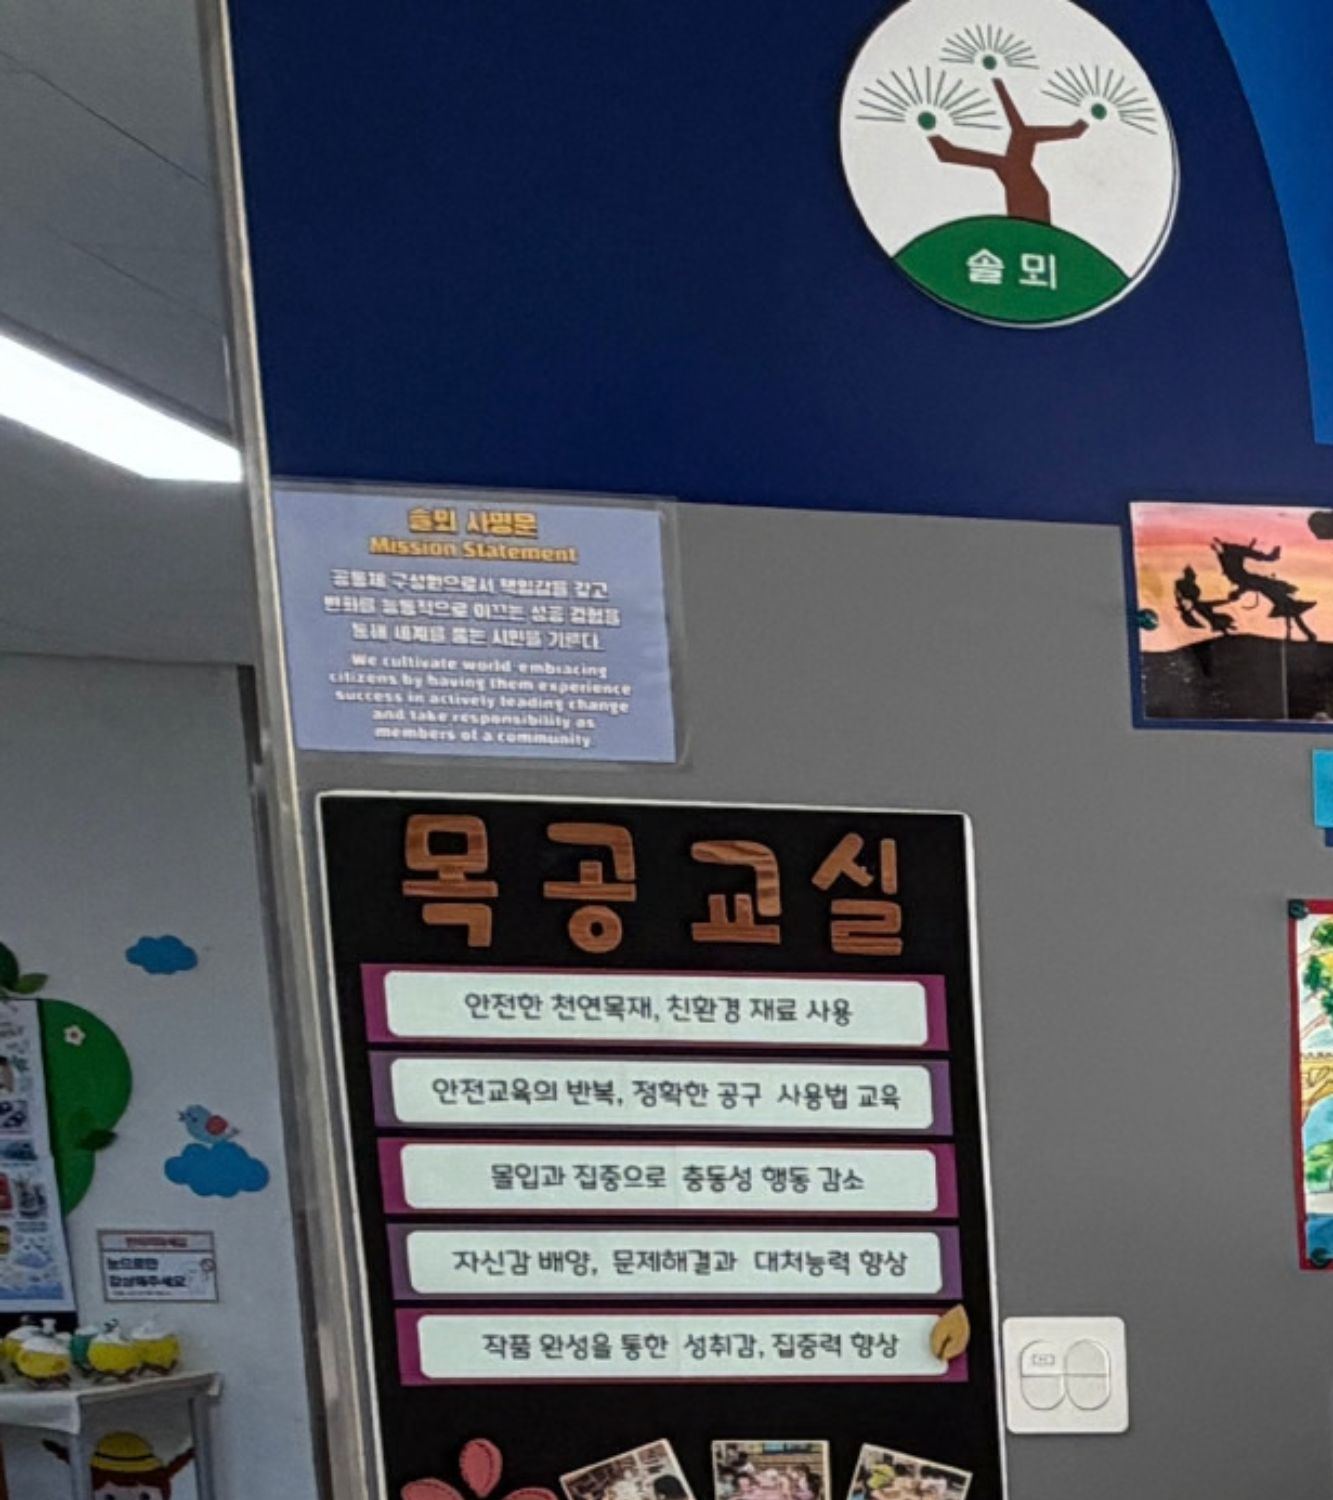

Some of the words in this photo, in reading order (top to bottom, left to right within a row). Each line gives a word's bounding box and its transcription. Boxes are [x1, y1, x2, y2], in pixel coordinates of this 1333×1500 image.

[966, 248, 1058, 291] 솔뫼
[368, 536, 457, 557] Mission
[462, 542, 579, 565] Statement
[473, 602, 527, 623] 이끄는
[352, 653, 377, 667] We
[382, 655, 457, 671] cultivate
[329, 672, 398, 685] citizens
[402, 674, 423, 688] by
[427, 676, 485, 691] having
[489, 678, 534, 691] them
[538, 681, 632, 698] experience
[407, 691, 425, 704] in
[429, 693, 495, 709] actively
[500, 695, 563, 712] leading
[569, 700, 629, 716] change
[372, 708, 405, 722] and
[410, 710, 448, 724] take
[452, 712, 571, 729] responsibility
[575, 717, 596, 730] as
[374, 725, 456, 741] members
[460, 728, 479, 742] of
[483, 731, 494, 743] a
[402, 814, 903, 955] 목공교실
[464, 992, 543, 1021] 안전한
[551, 994, 659, 1022] 천연목재,
[668, 995, 741, 1023] 친환경
[751, 998, 797, 1022] 재료
[806, 999, 853, 1027] 사용
[432, 1078, 557, 1105] 안전교육의
[566, 1079, 623, 1106] 반복,
[632, 1080, 709, 1108] 정확한
[717, 1081, 761, 1109] 공구
[777, 1082, 847, 1111] 사용법
[857, 1083, 901, 1110] 교육
[491, 1163, 565, 1190] 몰입과
[573, 1163, 666, 1192] 집중으로
[682, 1165, 752, 1193] 충동성
[761, 1165, 809, 1193] 행동
[817, 1166, 865, 1192] 감소
[451, 1249, 532, 1277] 자신감
[538, 1249, 598, 1277] 배양,
[612, 1249, 738, 1276] 문제해결과
[754, 1249, 850, 1277] 대처능력
[859, 1249, 908, 1277] 향상
[482, 1333, 531, 1361] 작품
[538, 1332, 613, 1361] 완성을
[620, 1333, 668, 1361] 통한
[684, 1332, 765, 1361] 성취감,
[771, 1333, 842, 1360] 집중력
[849, 1331, 899, 1360] 향상
